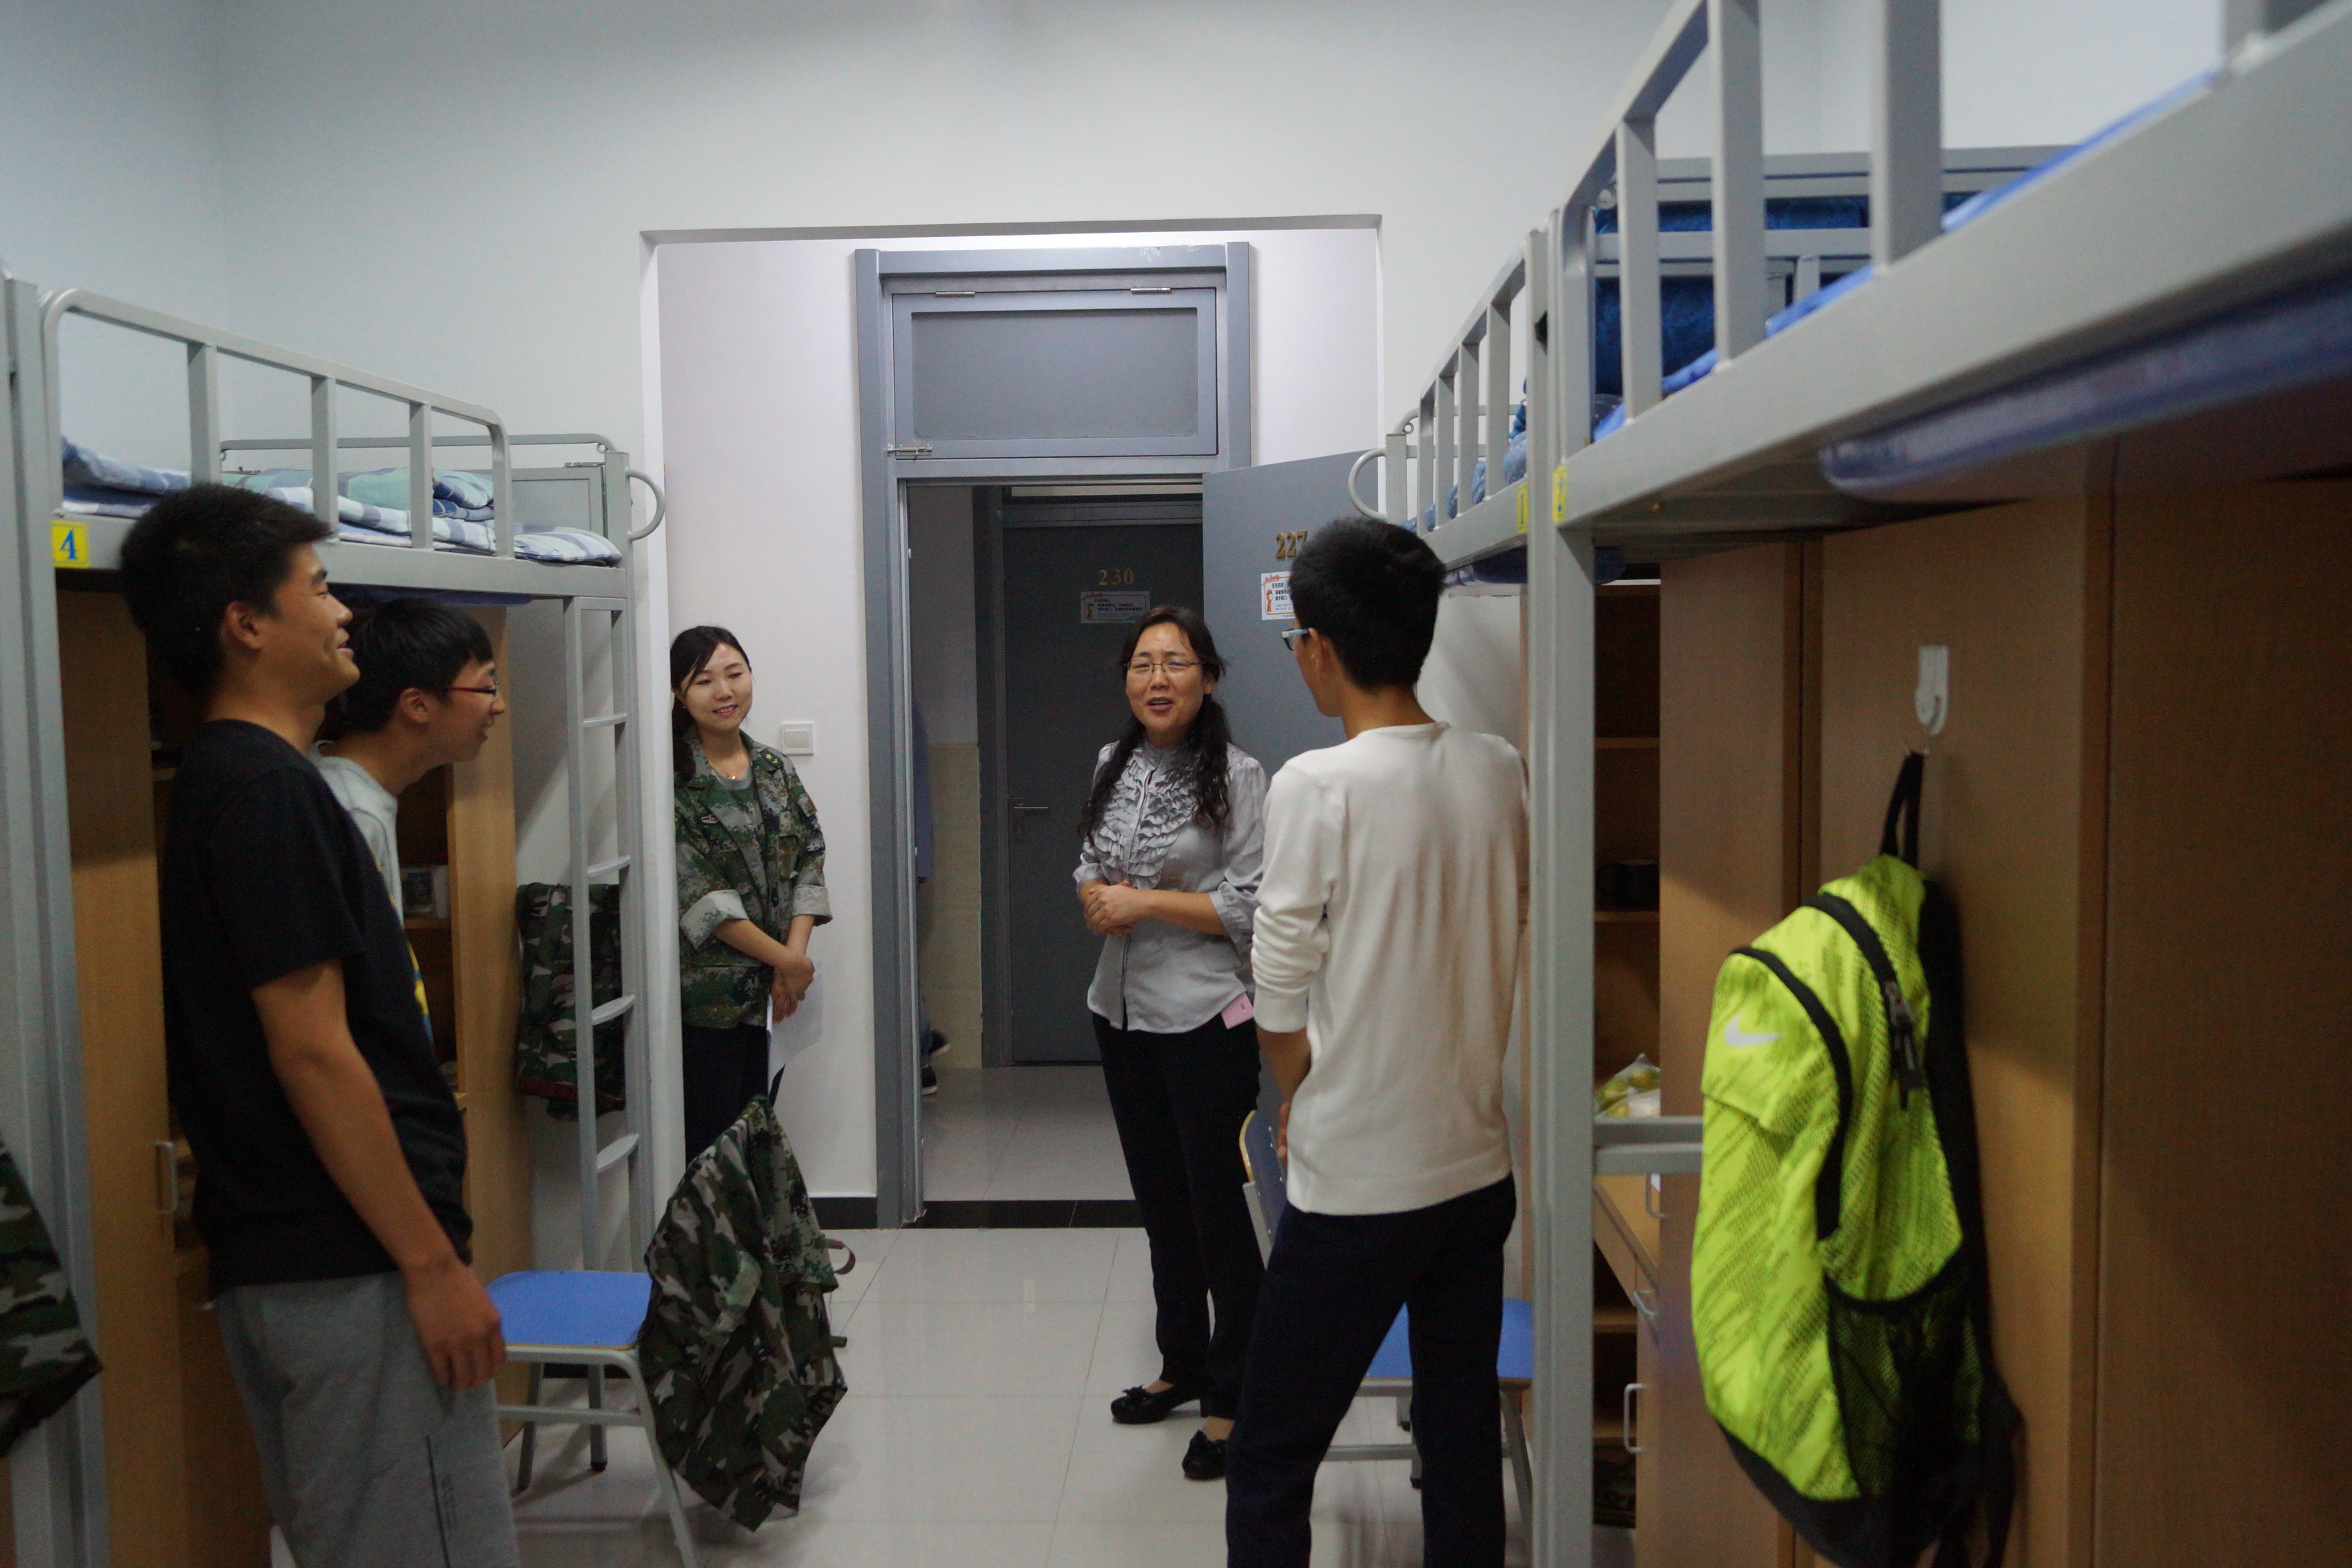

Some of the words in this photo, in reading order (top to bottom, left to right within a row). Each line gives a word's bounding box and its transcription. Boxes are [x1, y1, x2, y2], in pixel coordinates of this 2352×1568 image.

[60, 529, 77, 560] 4
[1276, 530, 1308, 558] 227
[1098, 568, 1134, 586] 230
